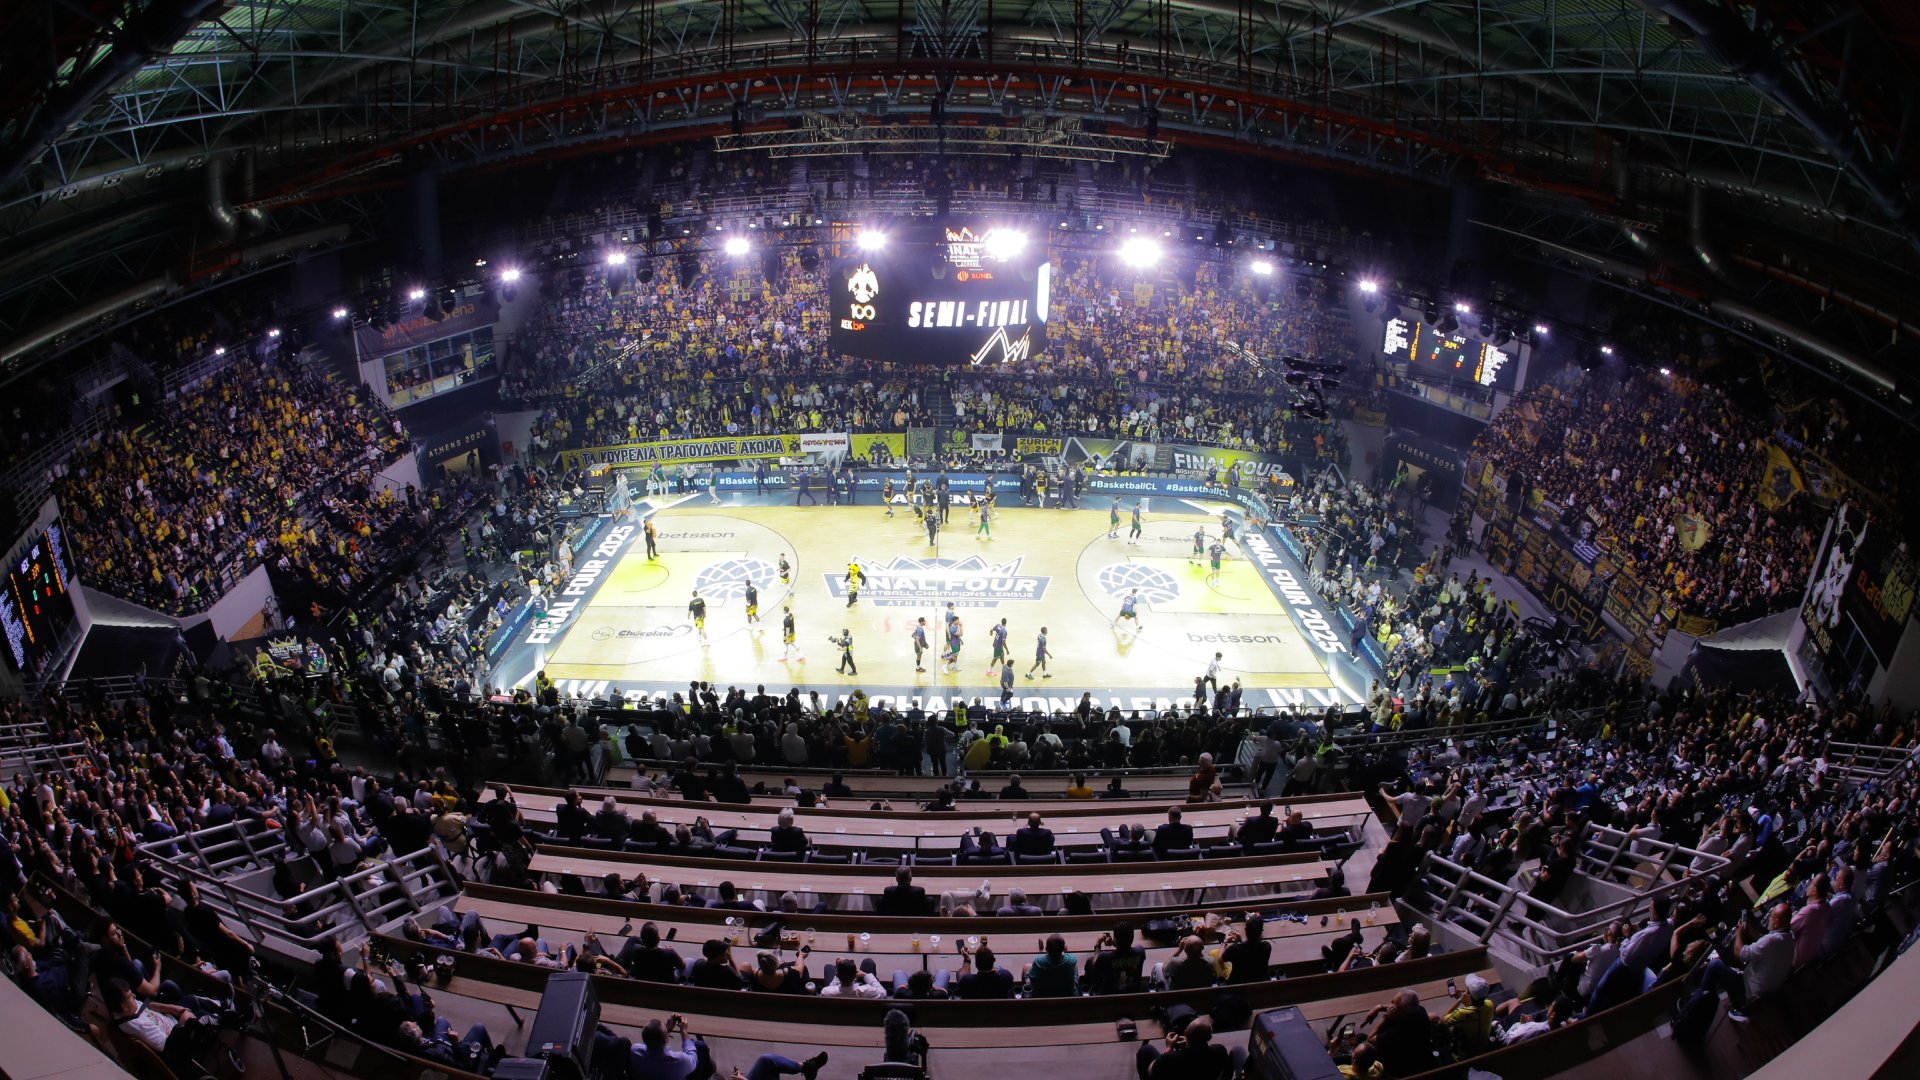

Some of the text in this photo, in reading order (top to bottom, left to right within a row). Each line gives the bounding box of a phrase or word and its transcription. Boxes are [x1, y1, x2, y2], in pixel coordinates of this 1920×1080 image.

[851, 304, 875, 320] 100
[908, 300, 1028, 328] SEMI-FINAL
[429, 430, 487, 457] ATHENS 2025
[659, 440, 737, 460] ΤΡΑΓΟΥΔΑΝΕ
[740, 438, 785, 455] ΑΚΟΜΑ
[1020, 438, 1059, 446] ZURICH
[1174, 453, 1229, 473] FINAL
[1433, 457, 1456, 472] 2025
[1090, 480, 1157, 491] #BasketballCL
[1166, 484, 1231, 498] #BasketballCL
[658, 531, 735, 539] betsson
[562, 560, 609, 595] FOUR
[592, 525, 635, 557] 2025
[835, 576, 1039, 592] FNAL FOUR
[1245, 533, 1347, 653] FINAL FOUR 2025
[1187, 632, 1282, 644] betsson
